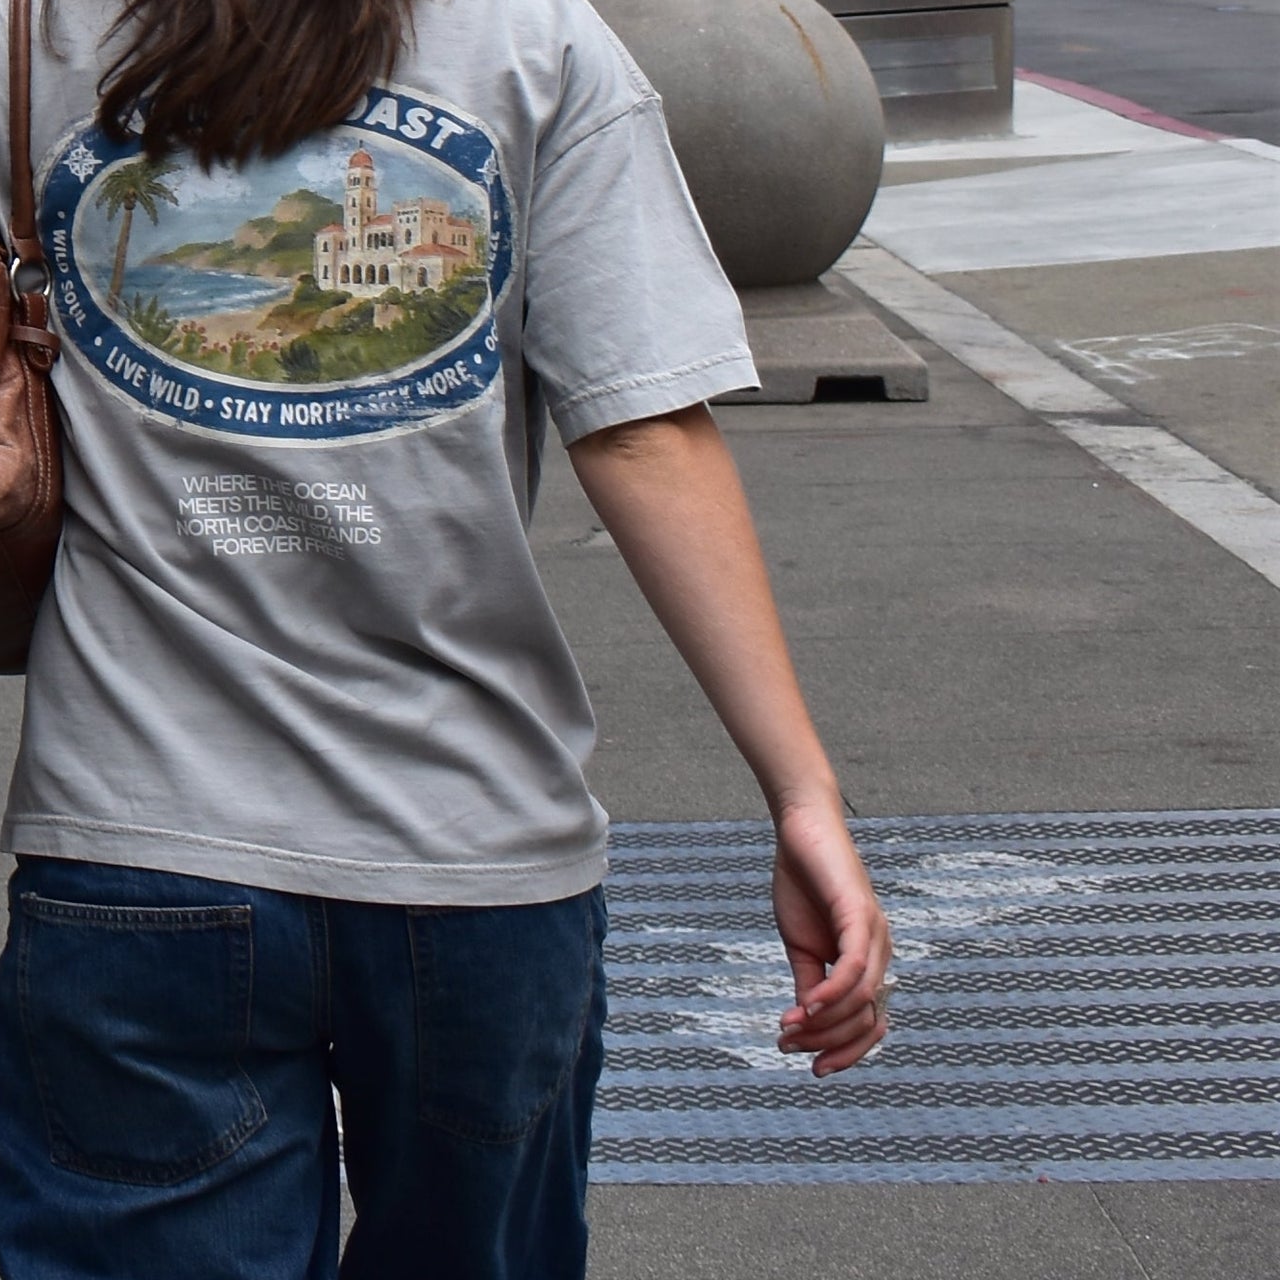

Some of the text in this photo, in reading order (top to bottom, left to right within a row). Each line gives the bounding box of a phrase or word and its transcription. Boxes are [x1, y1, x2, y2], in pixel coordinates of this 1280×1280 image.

[346, 94, 466, 151] AST
[52, 229, 87, 328] WILD SOUL
[105, 345, 147, 388] LIVE
[149, 370, 200, 411] WILD
[219, 396, 273, 424] STAY
[279, 395, 351, 426] NORTH
[416, 359, 472, 396] MORE
[182, 475, 367, 501] WHERE THE OCEAN
[178, 495, 374, 524] MEETS THE WILD, THE
[176, 515, 382, 545] NORTH COAST STANDS
[212, 536, 347, 561] FOREVER FREE
